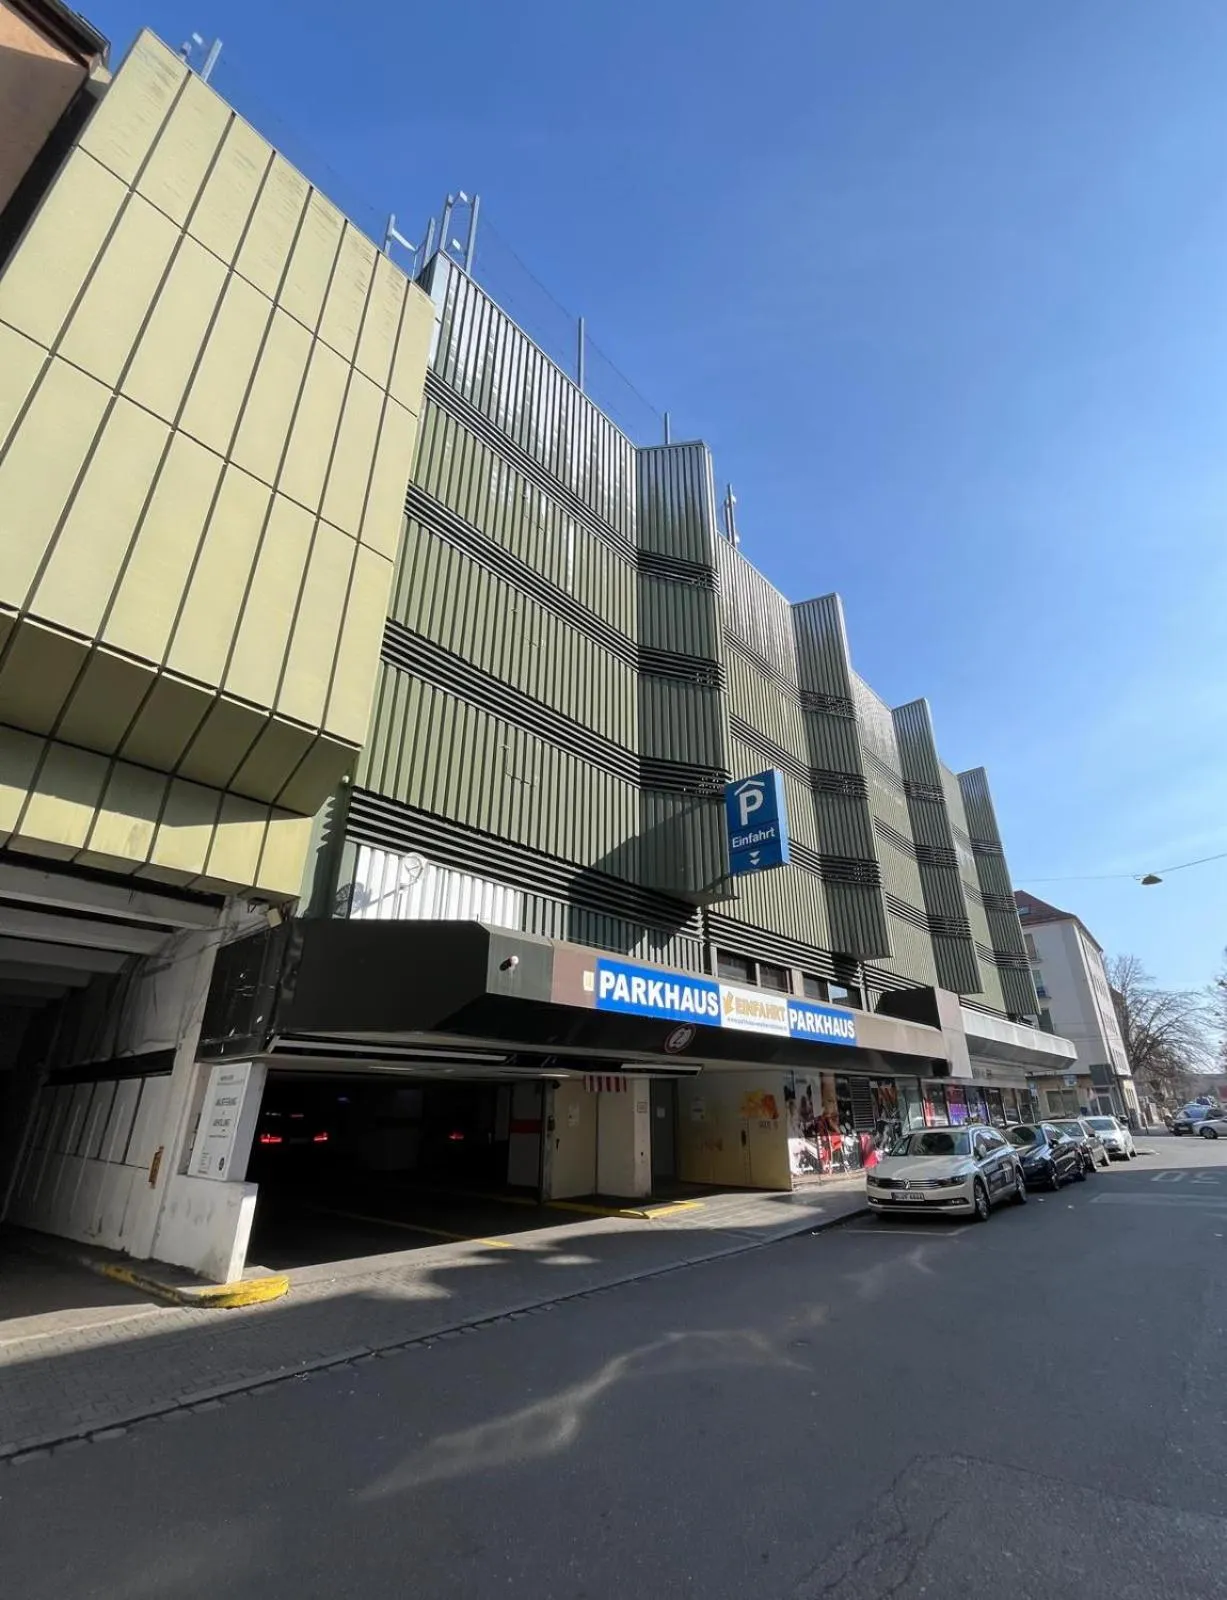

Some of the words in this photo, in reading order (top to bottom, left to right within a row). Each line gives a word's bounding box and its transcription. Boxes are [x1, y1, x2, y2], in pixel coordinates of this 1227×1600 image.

[739, 789, 764, 826] P
[732, 826, 775, 849] Einfahrt
[600, 969, 719, 1017] PARKHAUS
[789, 1008, 856, 1039] PARKHAUS
